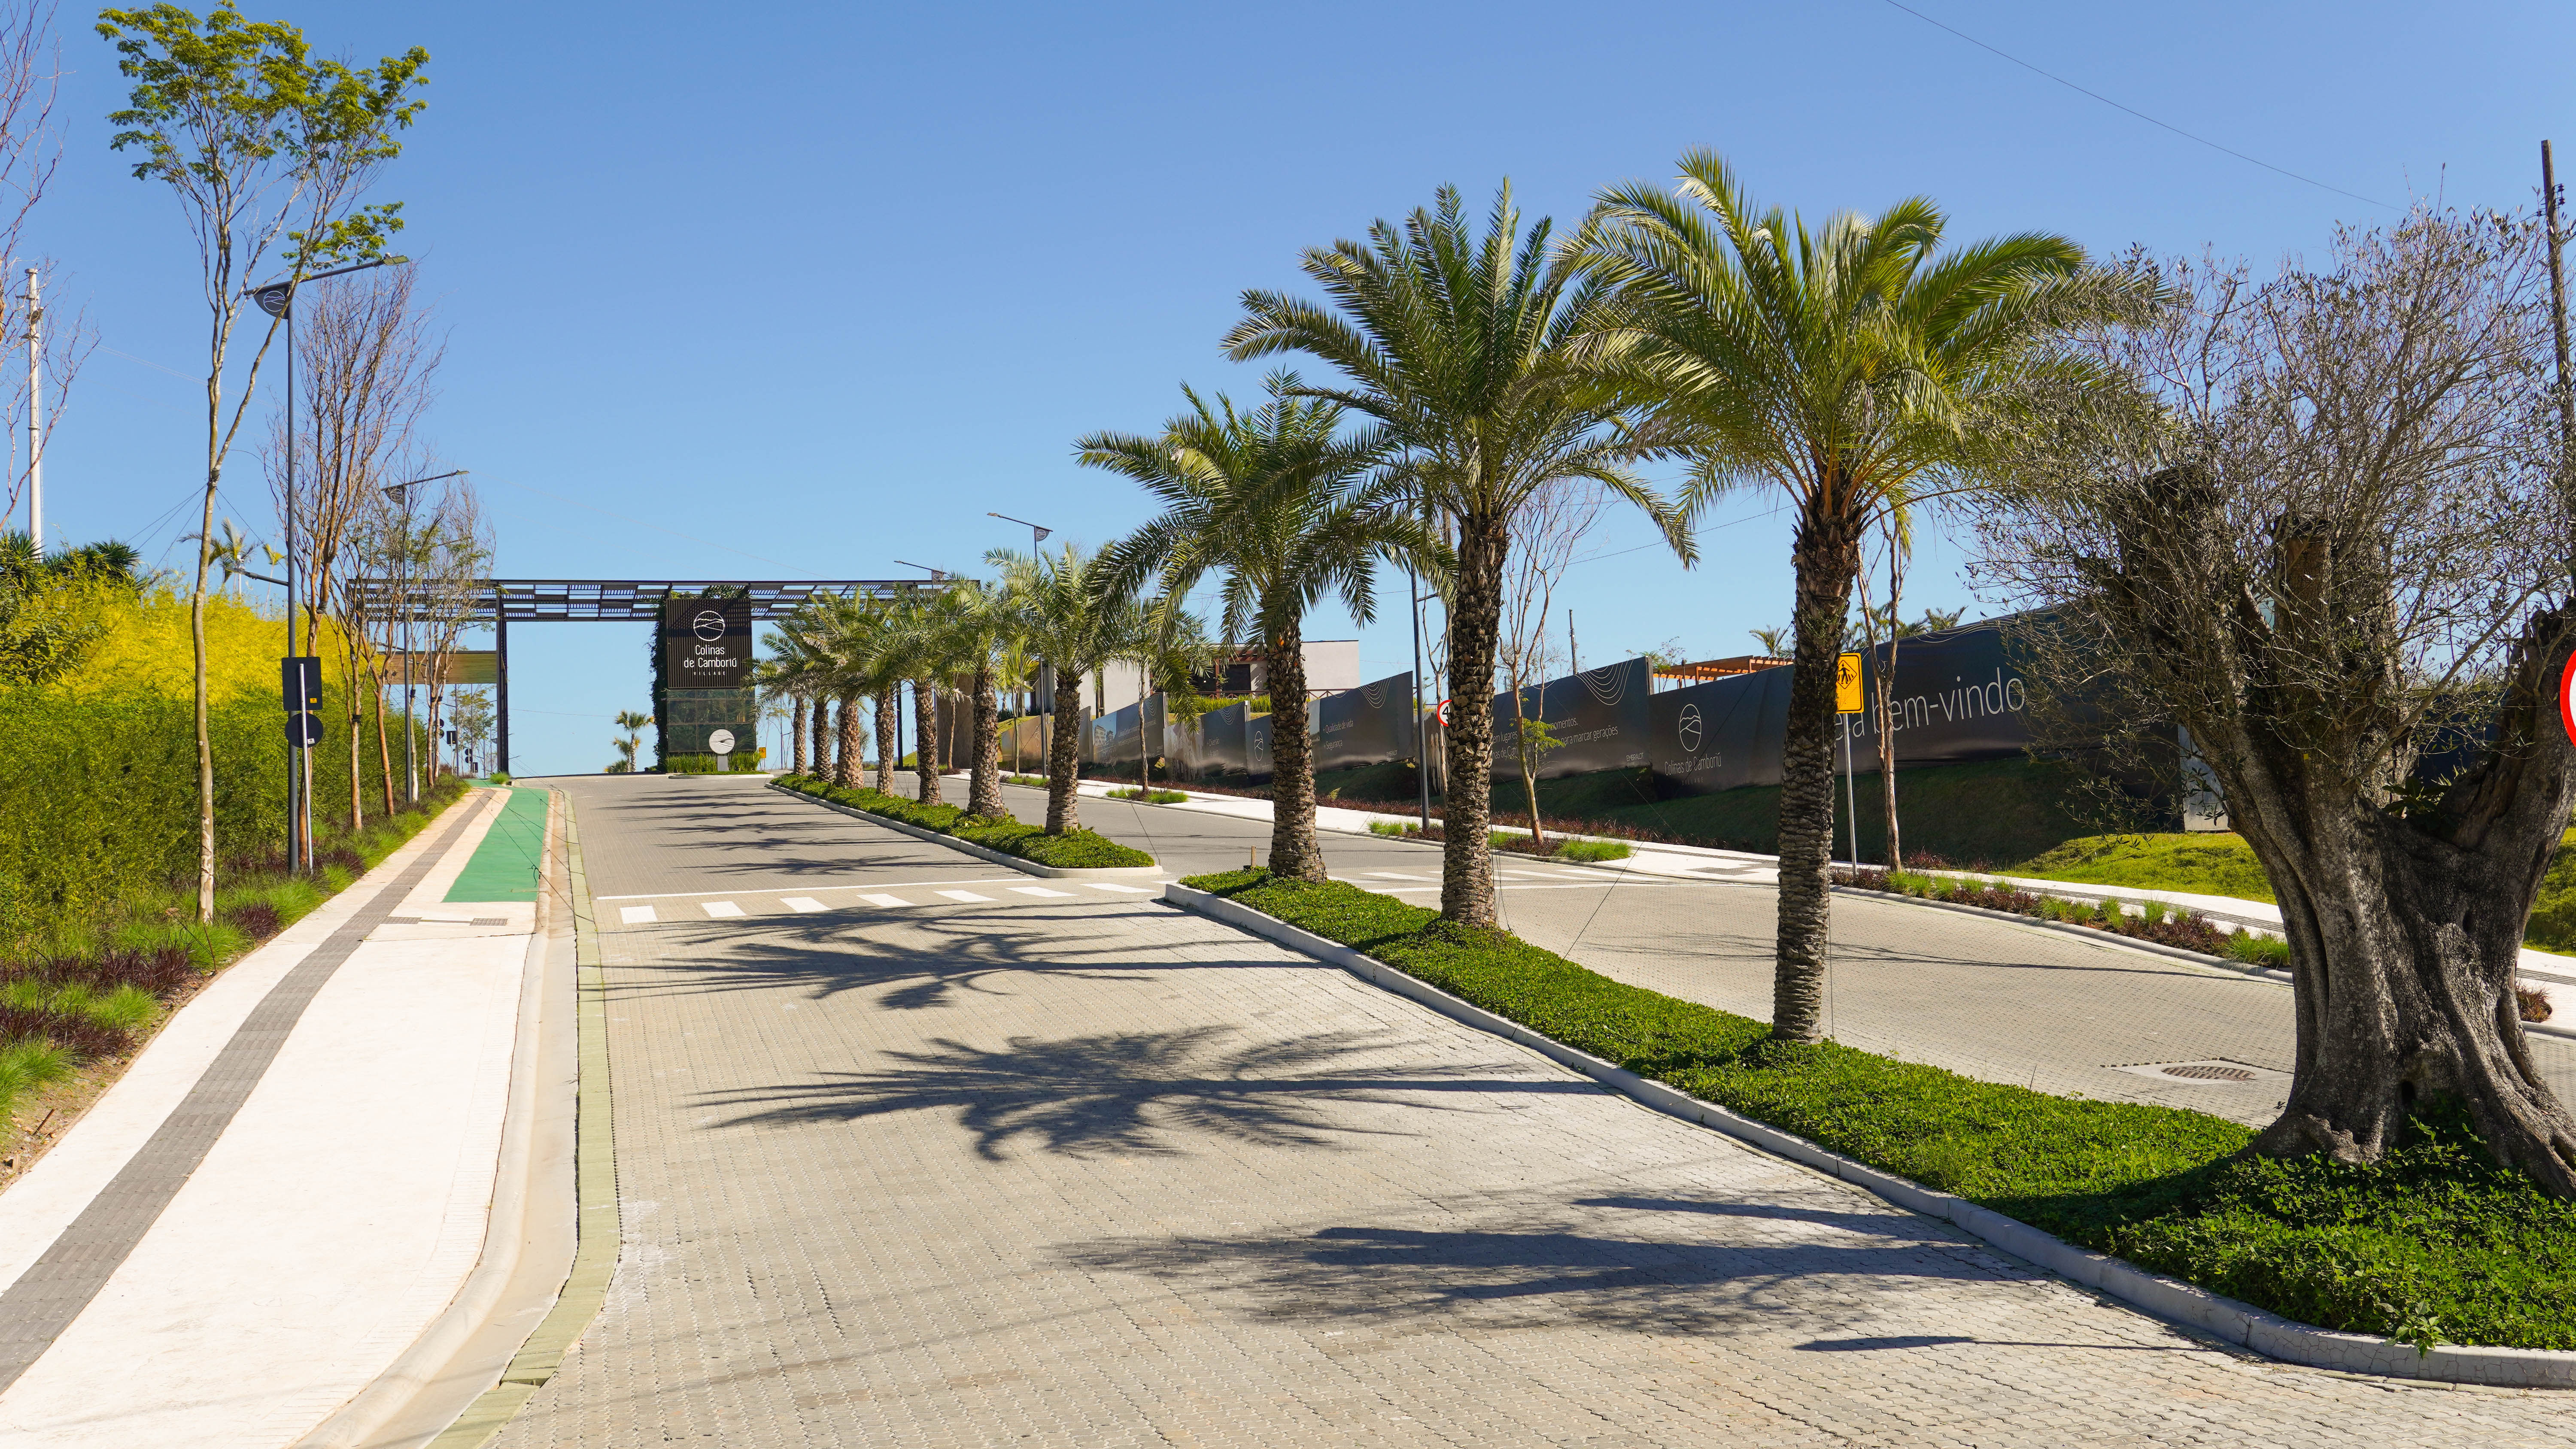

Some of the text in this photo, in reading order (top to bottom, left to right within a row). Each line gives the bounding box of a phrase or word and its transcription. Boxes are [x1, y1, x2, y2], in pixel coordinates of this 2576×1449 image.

[695, 645, 725, 655] Colinas
[684, 657, 737, 668] de Camboriú
[1871, 667, 2025, 734] bem-vindo
[1501, 731, 1518, 743] lugares
[1574, 731, 1593, 743] marcar
[1593, 724, 1618, 741] gerações
[1326, 740, 1343, 751] Segurança
[1665, 752, 1722, 776] Colinas de Camboriú
